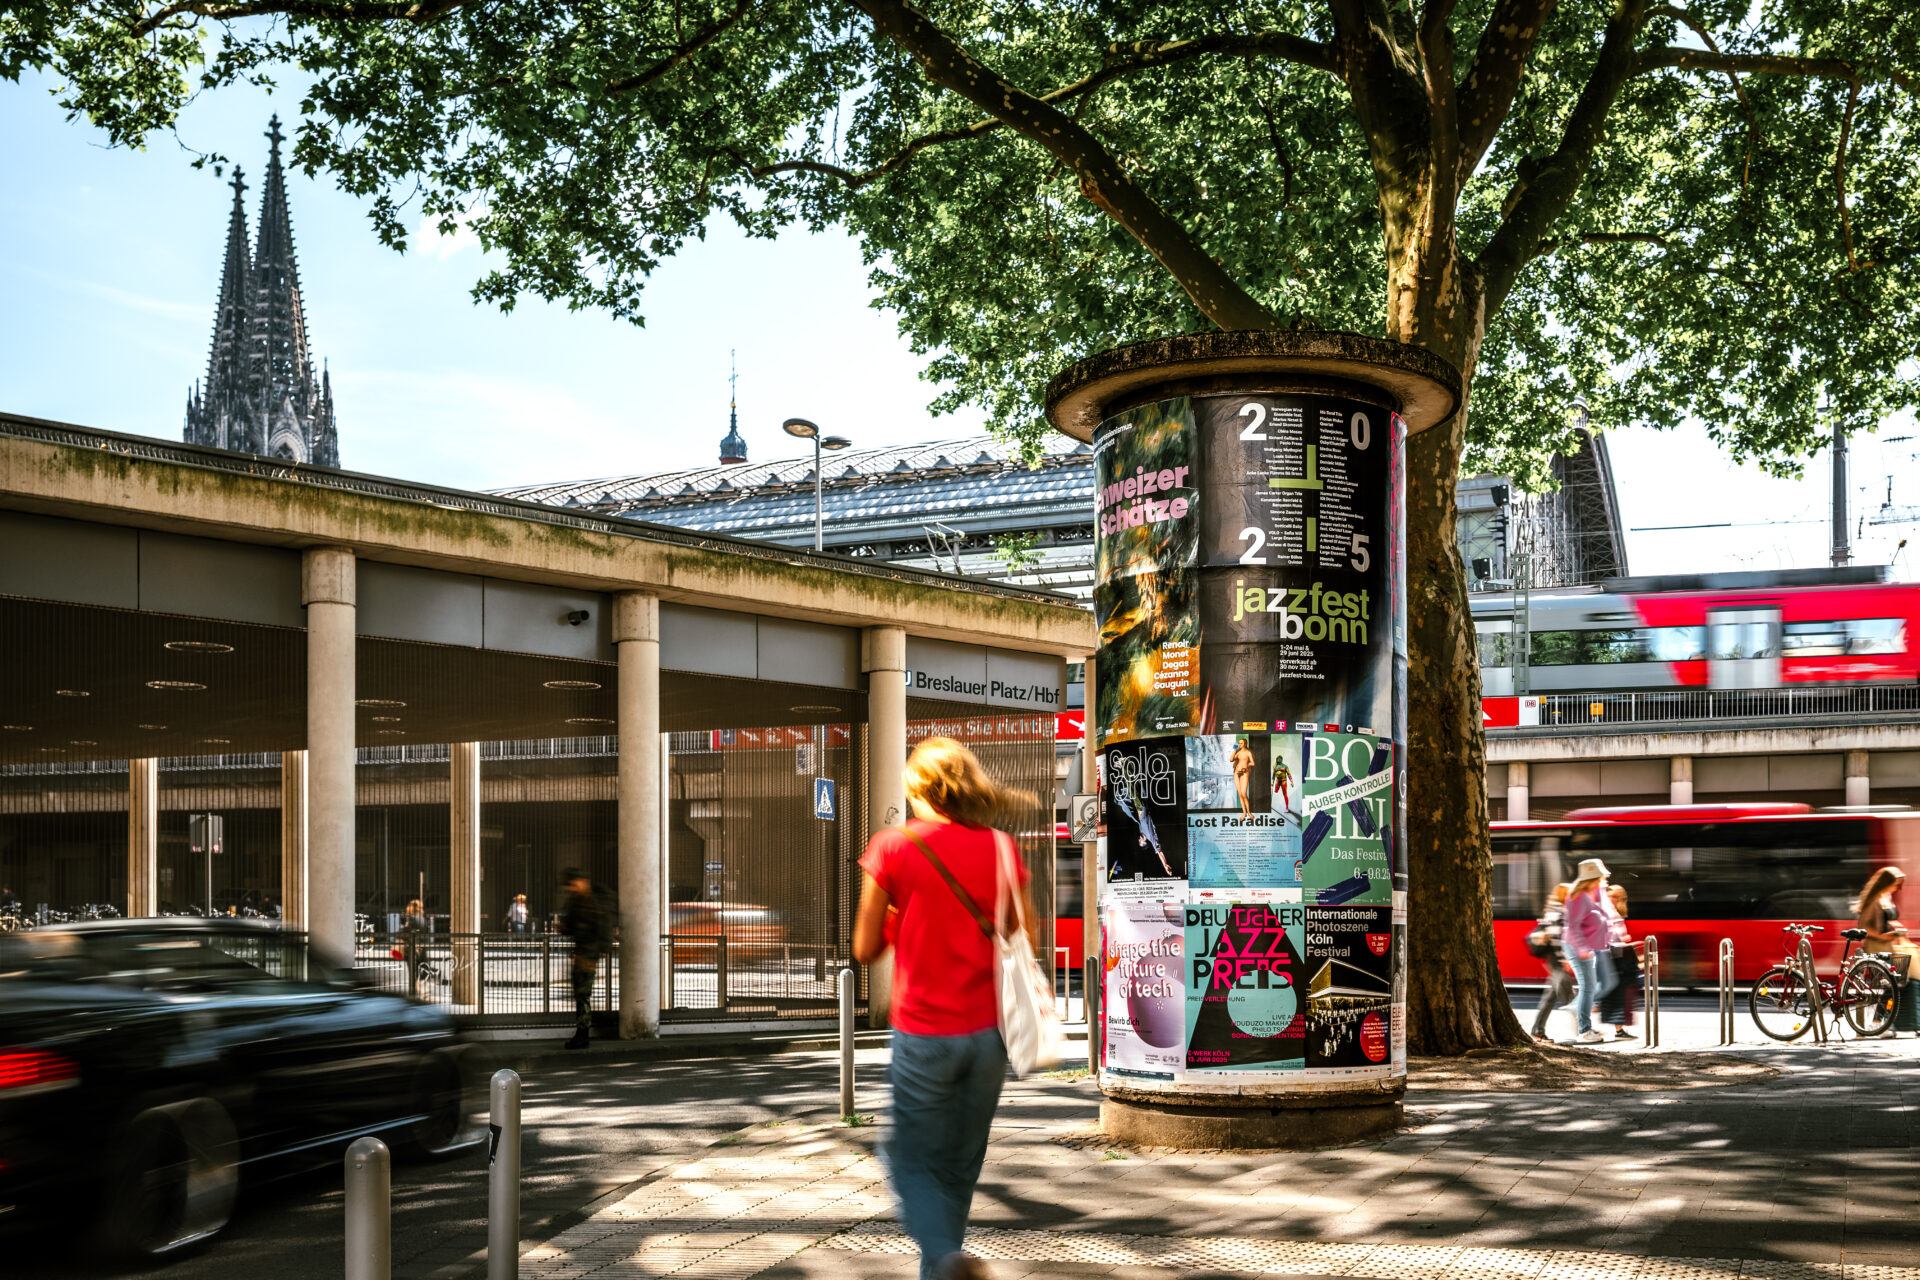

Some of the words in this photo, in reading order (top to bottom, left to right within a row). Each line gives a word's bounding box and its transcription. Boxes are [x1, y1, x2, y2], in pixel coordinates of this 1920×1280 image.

[1239, 403, 1267, 441] 2
[1351, 412, 1370, 450] 0
[1239, 527, 1266, 565] 2
[1351, 534, 1370, 572] 5
[1233, 580, 1370, 622] jazzfest
[1280, 607, 1367, 645] bonn
[1163, 639, 1189, 650] Renoir
[1163, 650, 1189, 659] Monet
[1163, 660, 1189, 670] Degas
[1154, 670, 1189, 679] Cézanne
[1280, 672, 1325, 680] jazzfest-bonn.de
[916, 672, 986, 695] Breslauer
[991, 681, 1060, 704] Platz/Hbf
[1154, 679, 1189, 690] Gauguin
[966, 720, 992, 736] Sie
[1110, 746, 1169, 784] Solo
[1308, 793, 1342, 811] AUßER
[1188, 816, 1217, 828] Lost
[1222, 815, 1285, 828] Paradise
[1331, 847, 1354, 860] Das
[1356, 848, 1387, 860] Festiva
[1306, 908, 1378, 919] Internationale
[1306, 921, 1369, 932] Photoszene
[1195, 928, 1289, 958] JAZZ
[1306, 934, 1333, 944] Köln
[1110, 940, 1147, 962] shape
[1150, 939, 1180, 957] the
[1306, 946, 1350, 957] Festival
[1119, 960, 1166, 978] future
[1194, 959, 1293, 990] PREIS
[1119, 978, 1132, 998] of
[1135, 978, 1173, 998] tech
[1109, 1016, 1125, 1025] Bewirb
[1126, 1017, 1140, 1026] dich
